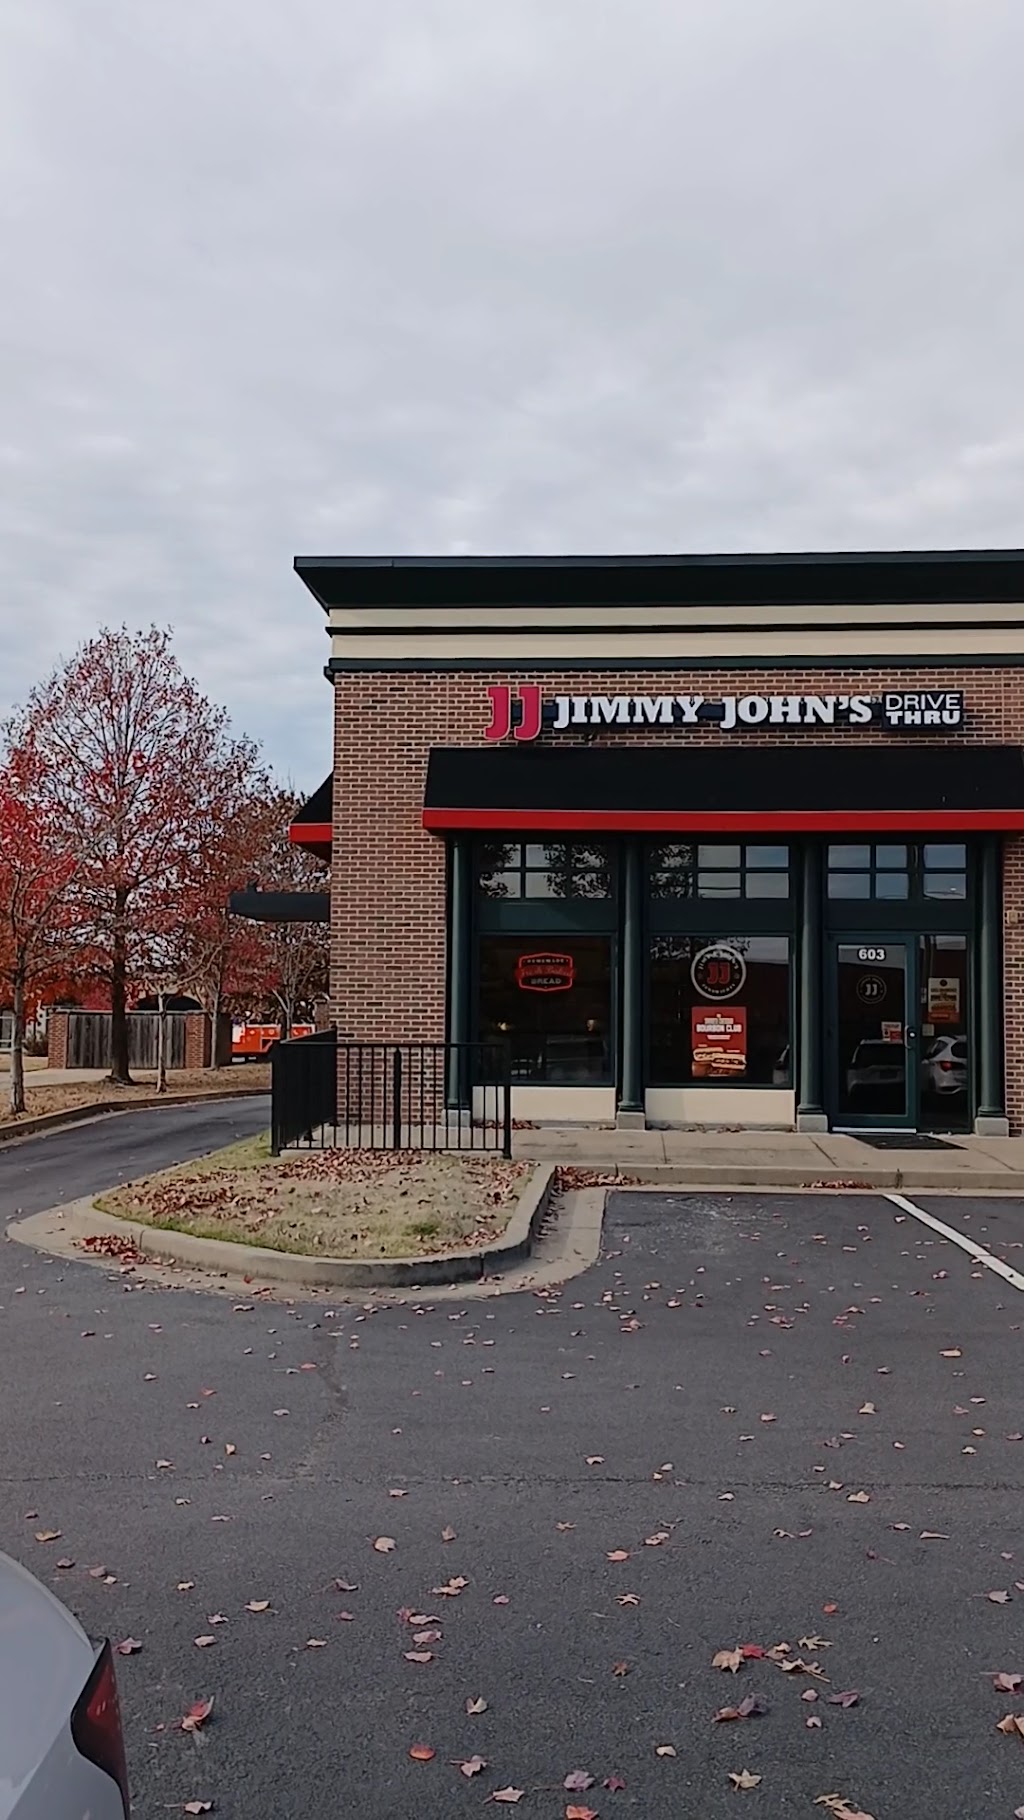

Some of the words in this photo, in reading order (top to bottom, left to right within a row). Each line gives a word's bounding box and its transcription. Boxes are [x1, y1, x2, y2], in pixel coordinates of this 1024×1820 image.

[885, 693, 961, 710] DRIVE
[484, 684, 542, 741] JJ
[553, 695, 704, 729] JIMMY
[720, 694, 873, 729] JOHN'S
[885, 710, 961, 725] THRU
[858, 948, 886, 961] 603
[706, 961, 731, 985] JJ
[864, 983, 878, 996] JJ
